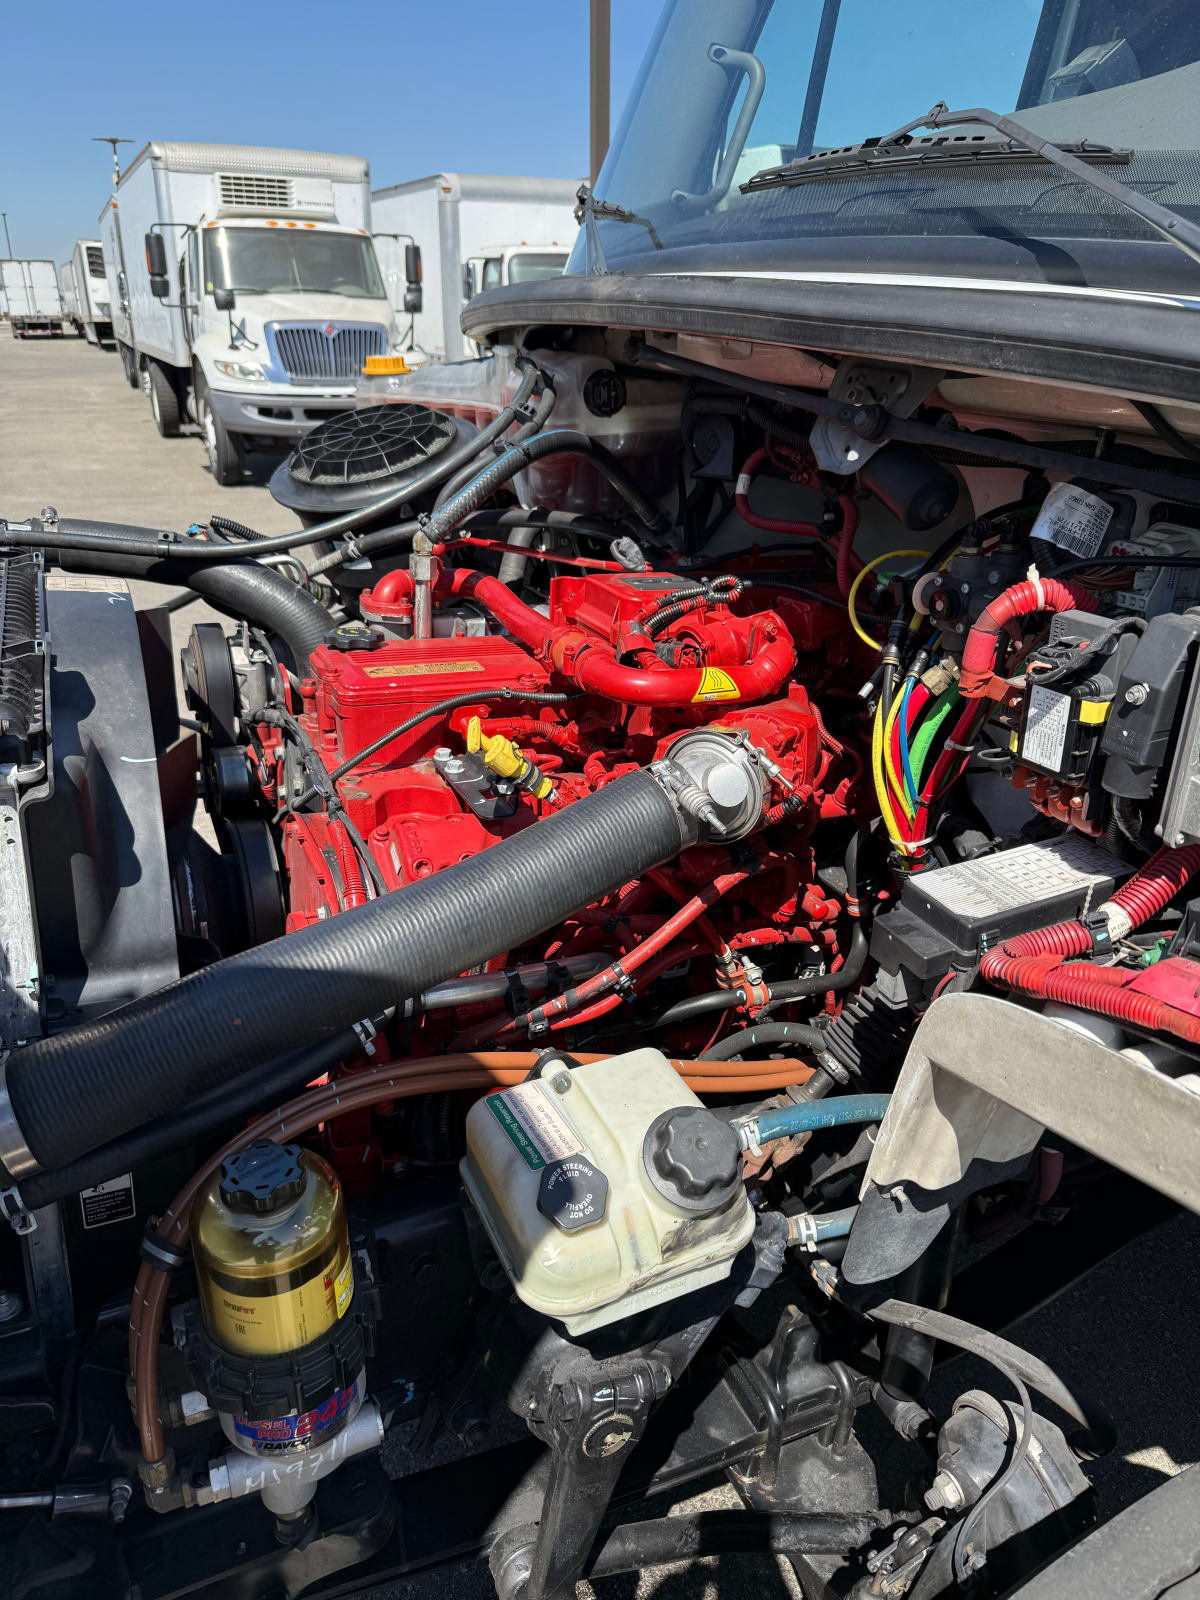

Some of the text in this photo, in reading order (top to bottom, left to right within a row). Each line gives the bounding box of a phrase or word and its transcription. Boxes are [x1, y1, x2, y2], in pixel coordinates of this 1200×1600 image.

[493, 1100, 541, 1164] Power Steering Reservoir
[547, 1163, 593, 1190] POWER STEERING
[558, 1170, 580, 1182] FLUID
[565, 1193, 593, 1211] OVERFILL
[569, 1205, 594, 1219] DO NOT
[294, 1385, 354, 1438] 245
[235, 1415, 291, 1430] DIESEL
[257, 1429, 292, 1440] PRO
[262, 1436, 312, 1450] DAVCO
